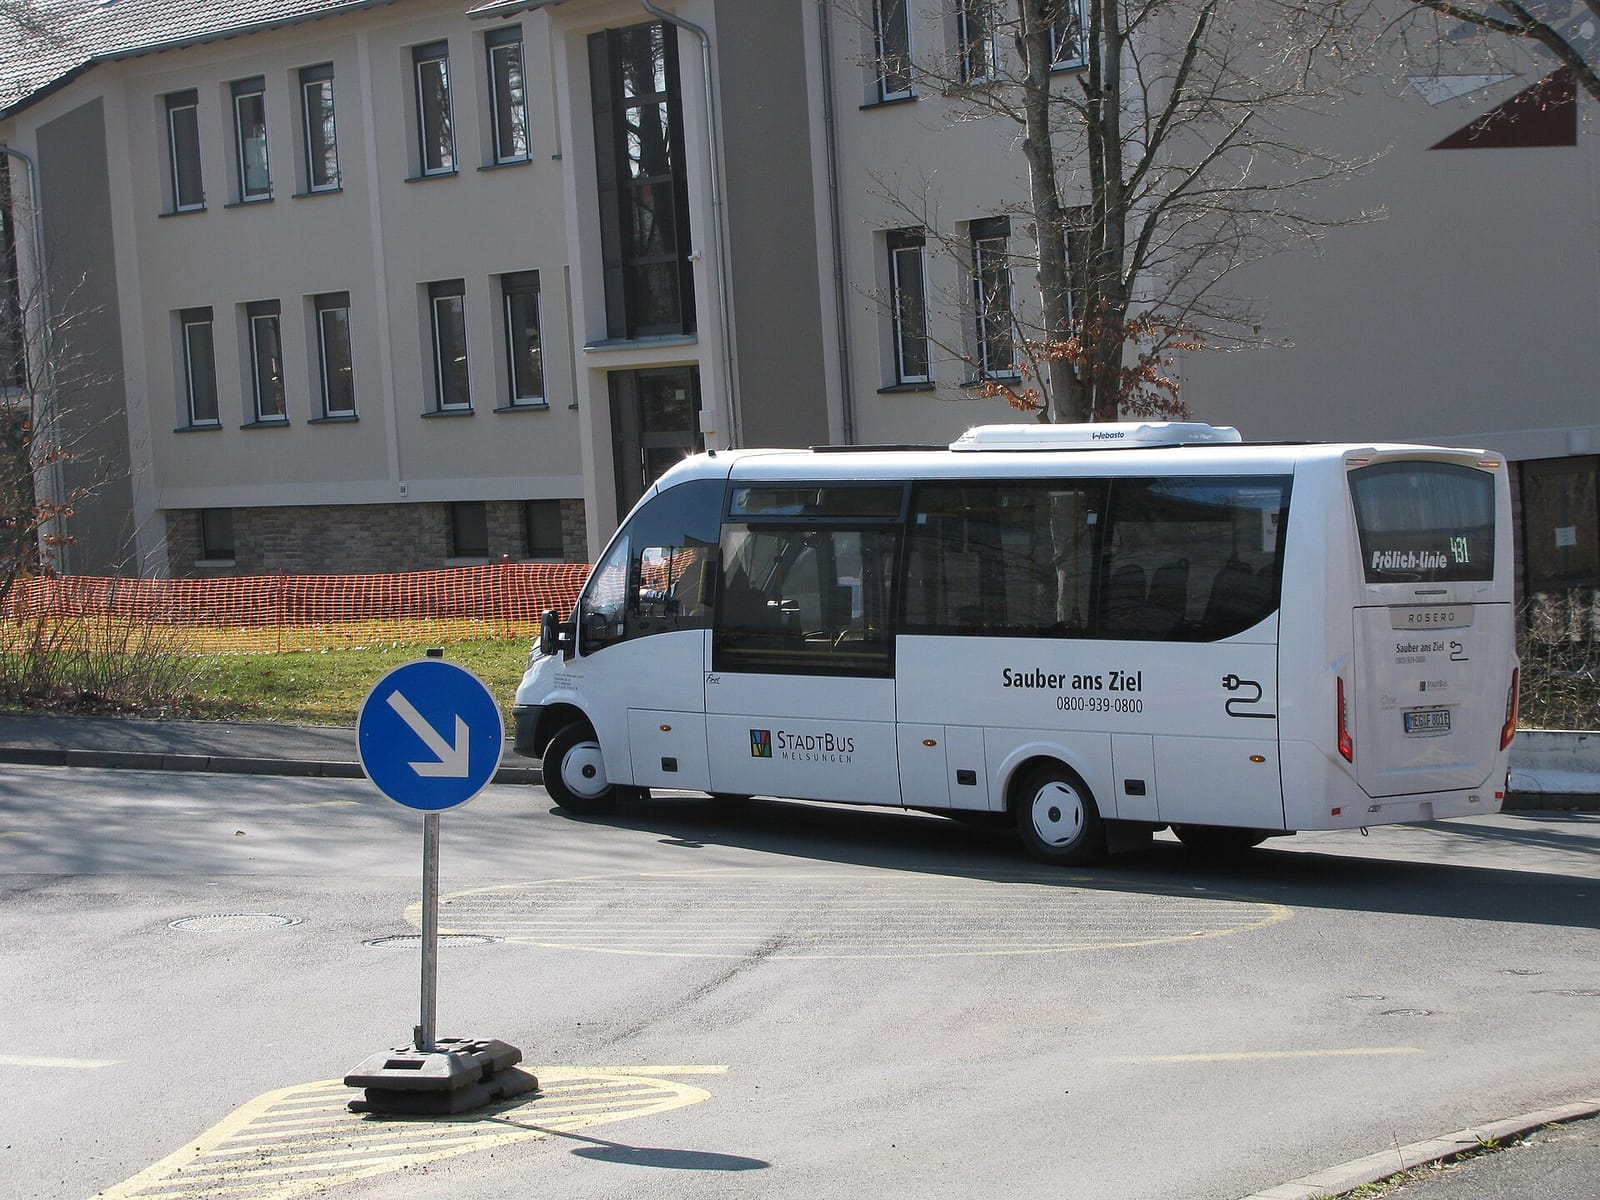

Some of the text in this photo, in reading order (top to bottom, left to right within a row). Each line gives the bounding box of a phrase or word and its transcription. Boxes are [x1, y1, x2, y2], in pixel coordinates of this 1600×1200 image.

[1092, 431, 1125, 440] Webasto
[1450, 536, 1470, 563] 431
[1408, 613, 1455, 623] ROSERO
[1396, 643, 1419, 653] Sauber
[1432, 641, 1445, 652] Ziel
[1002, 667, 1142, 692] Sauber ans Ziel
[1056, 696, 1143, 713] 0800-939-0800
[782, 752, 852, 763] MELSUNGEN
